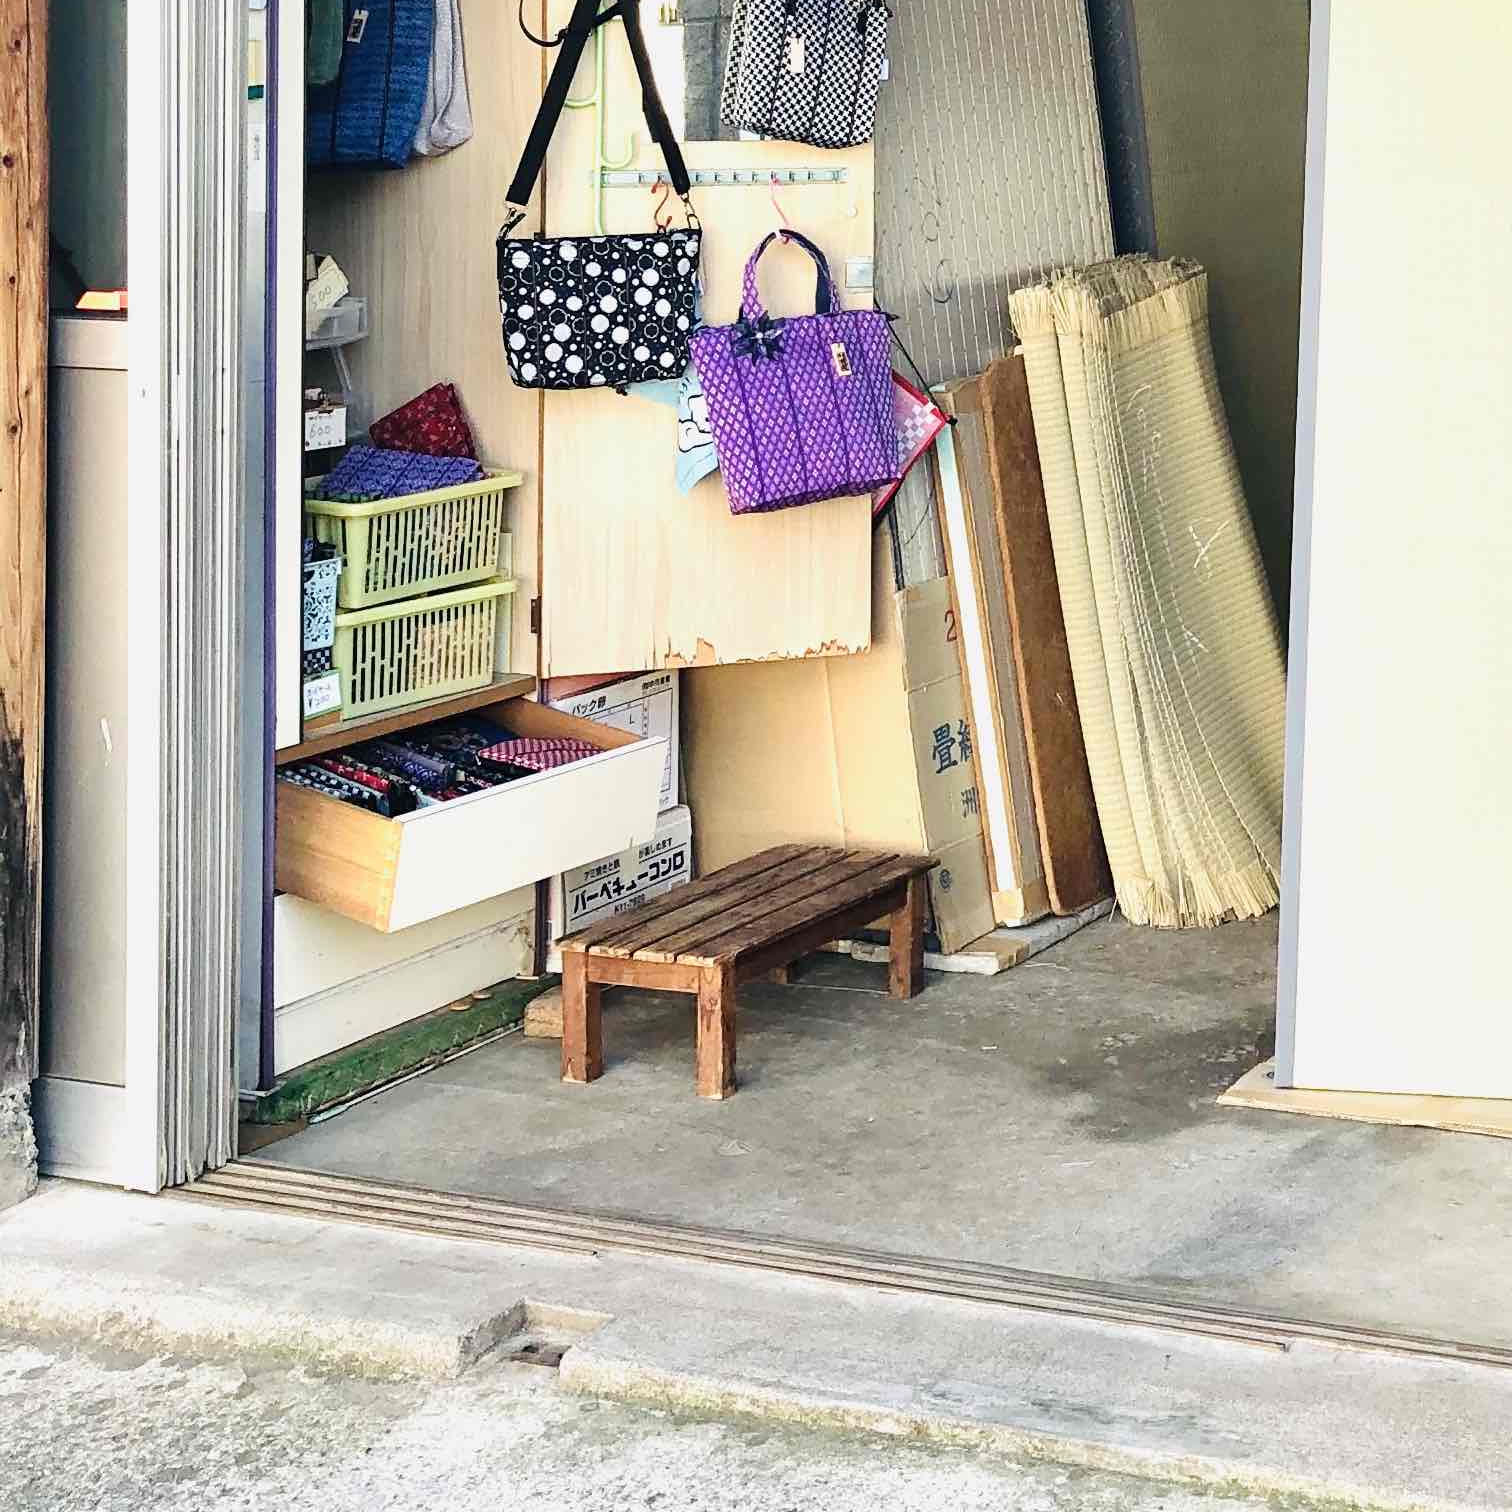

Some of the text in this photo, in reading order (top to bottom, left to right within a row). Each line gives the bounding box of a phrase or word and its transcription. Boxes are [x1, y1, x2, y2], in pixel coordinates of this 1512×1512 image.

[573, 850, 685, 914] バーベキューコンロ
